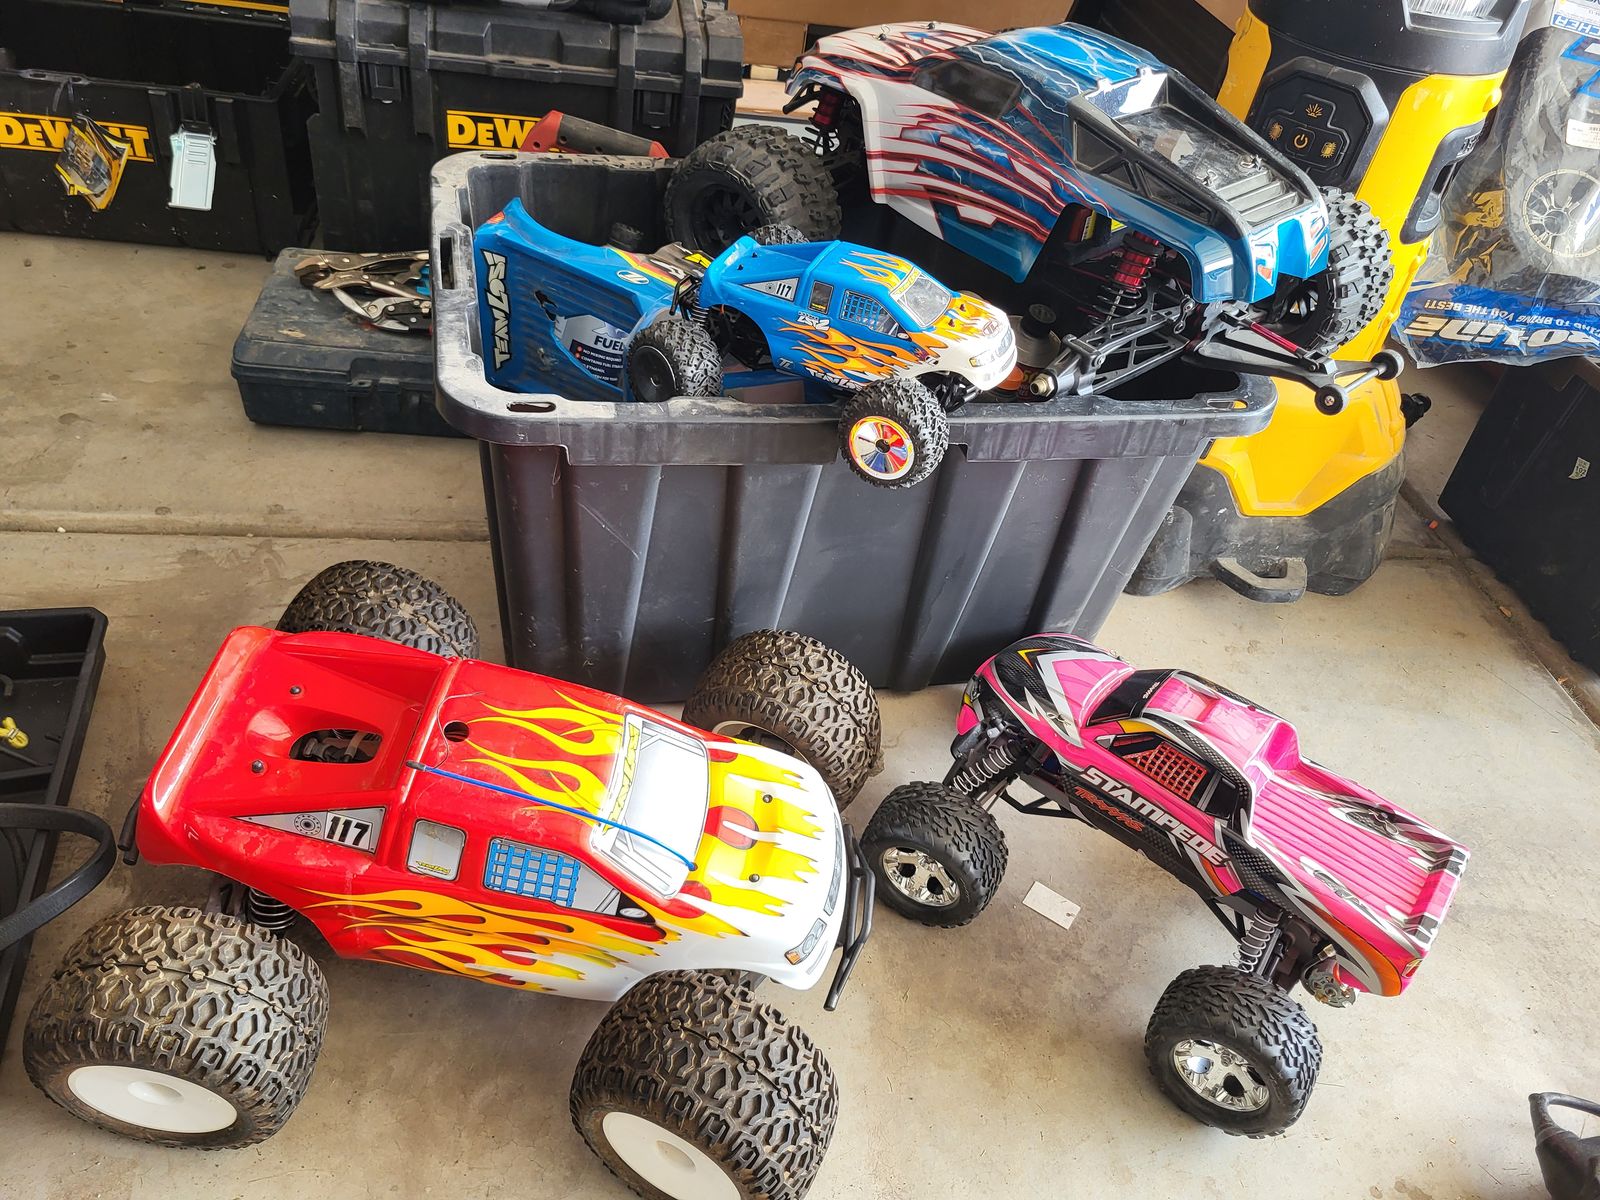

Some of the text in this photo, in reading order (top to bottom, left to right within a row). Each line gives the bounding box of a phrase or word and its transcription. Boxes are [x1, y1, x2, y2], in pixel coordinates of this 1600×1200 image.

[776, 282, 792, 298] 117
[1424, 300, 1463, 312] BEST!
[1464, 304, 1488, 315] THE
[1516, 314, 1553, 326] BRING
[1074, 785, 1146, 832] TRAXXAS
[1080, 767, 1229, 866] STAMPEDE
[326, 815, 371, 846] 117
